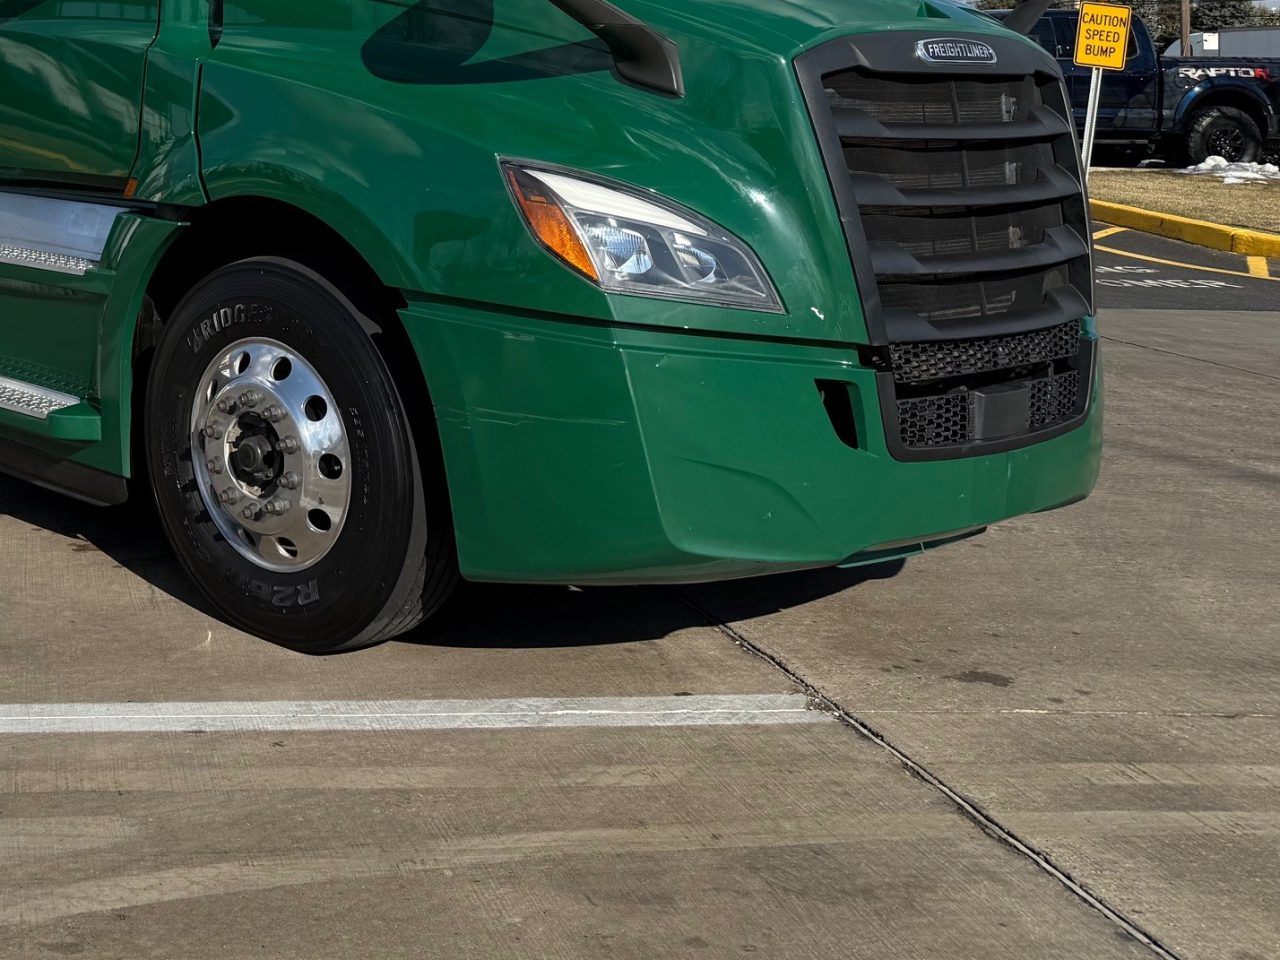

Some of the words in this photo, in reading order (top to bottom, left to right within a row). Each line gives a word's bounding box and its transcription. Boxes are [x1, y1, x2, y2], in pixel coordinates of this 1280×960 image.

[1082, 12, 1127, 28] CAUTION
[1084, 28, 1120, 43] SPEED
[927, 42, 991, 58] FREIGHTLINER
[1084, 43, 1116, 58] BUMP
[1178, 67, 1271, 81] RAPTOR
